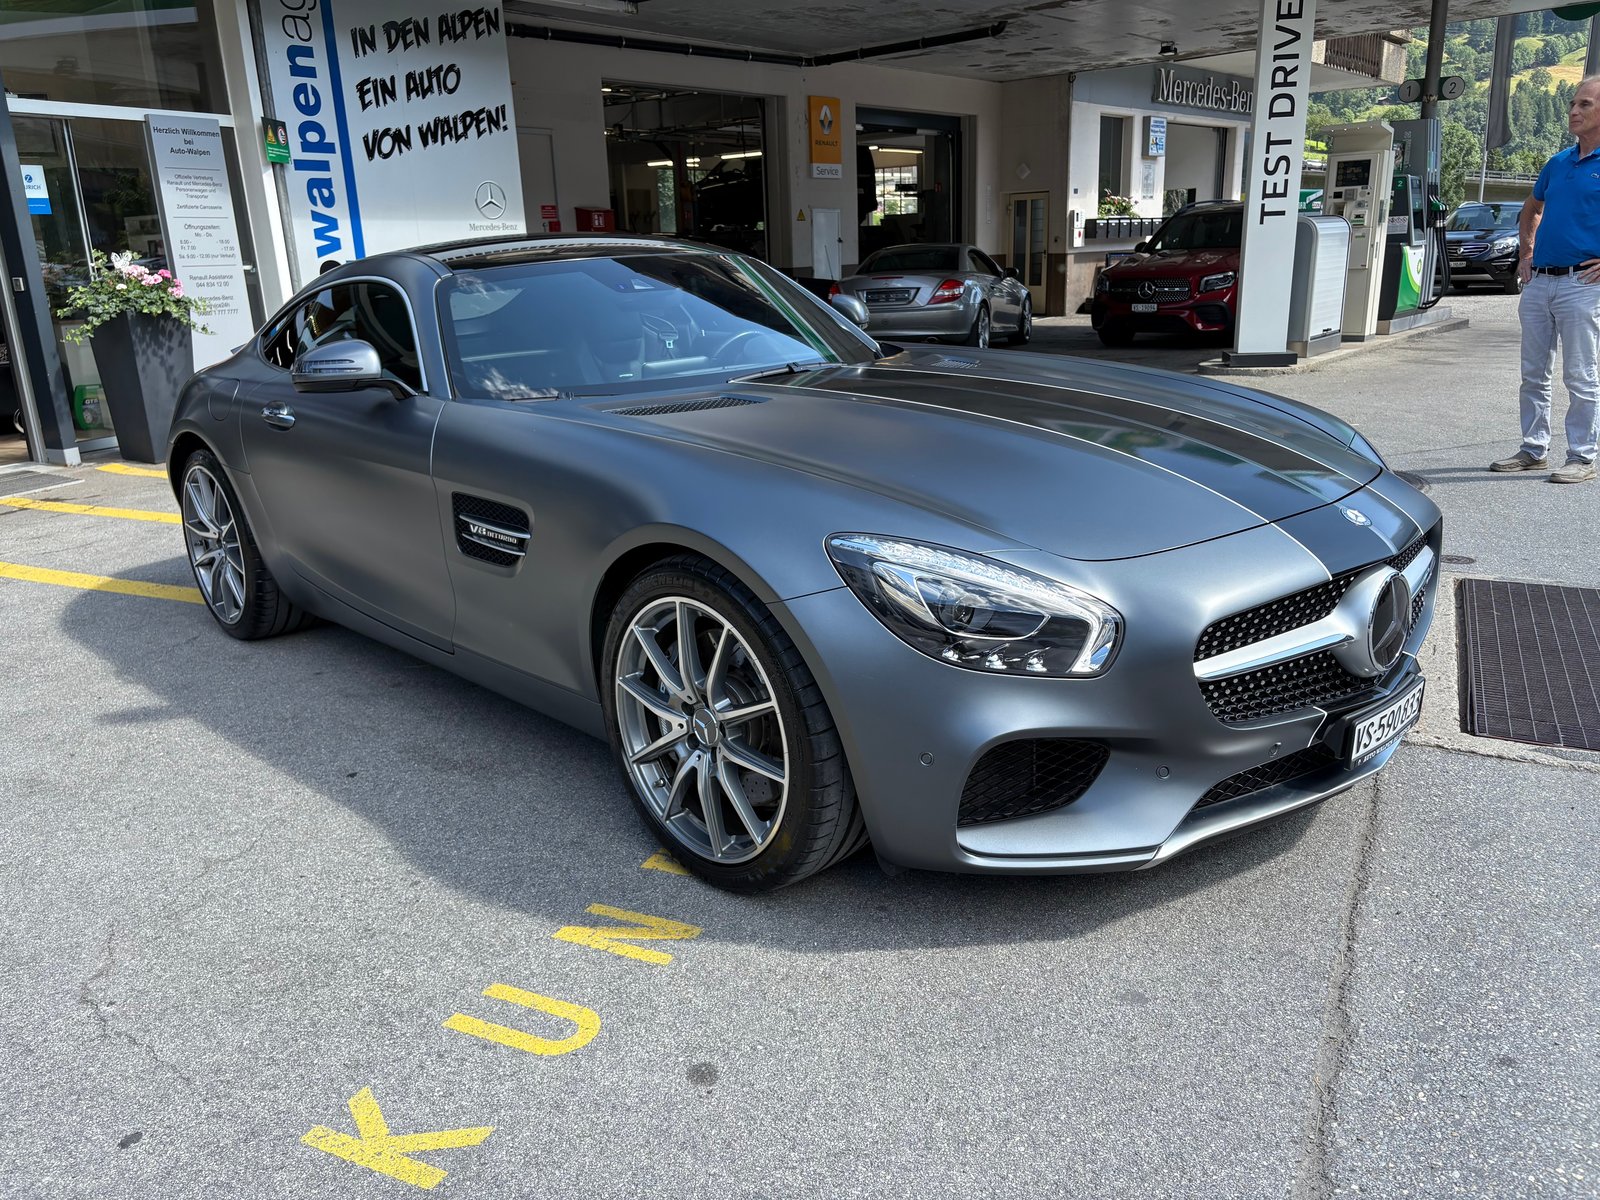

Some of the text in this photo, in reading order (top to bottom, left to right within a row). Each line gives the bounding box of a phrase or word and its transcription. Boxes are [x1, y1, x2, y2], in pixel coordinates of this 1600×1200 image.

[350, 7, 500, 58] IN DEN ALPEN
[356, 63, 461, 112] EIN AUTO
[1158, 68, 1254, 113] Mercedes-Ben
[1406, 86, 1412, 96] 1
[1449, 82, 1457, 94] 2
[1260, 0, 1303, 224] TEST DRIVE
[153, 126, 219, 137] Herzlich Willkommen
[362, 104, 508, 161] VON WALPEN!
[170, 148, 210, 156] Auto-Walpen
[816, 166, 840, 176] Service
[469, 223, 518, 232] Mercedes-Benz
[470, 524, 517, 544] V8 BITURBO
